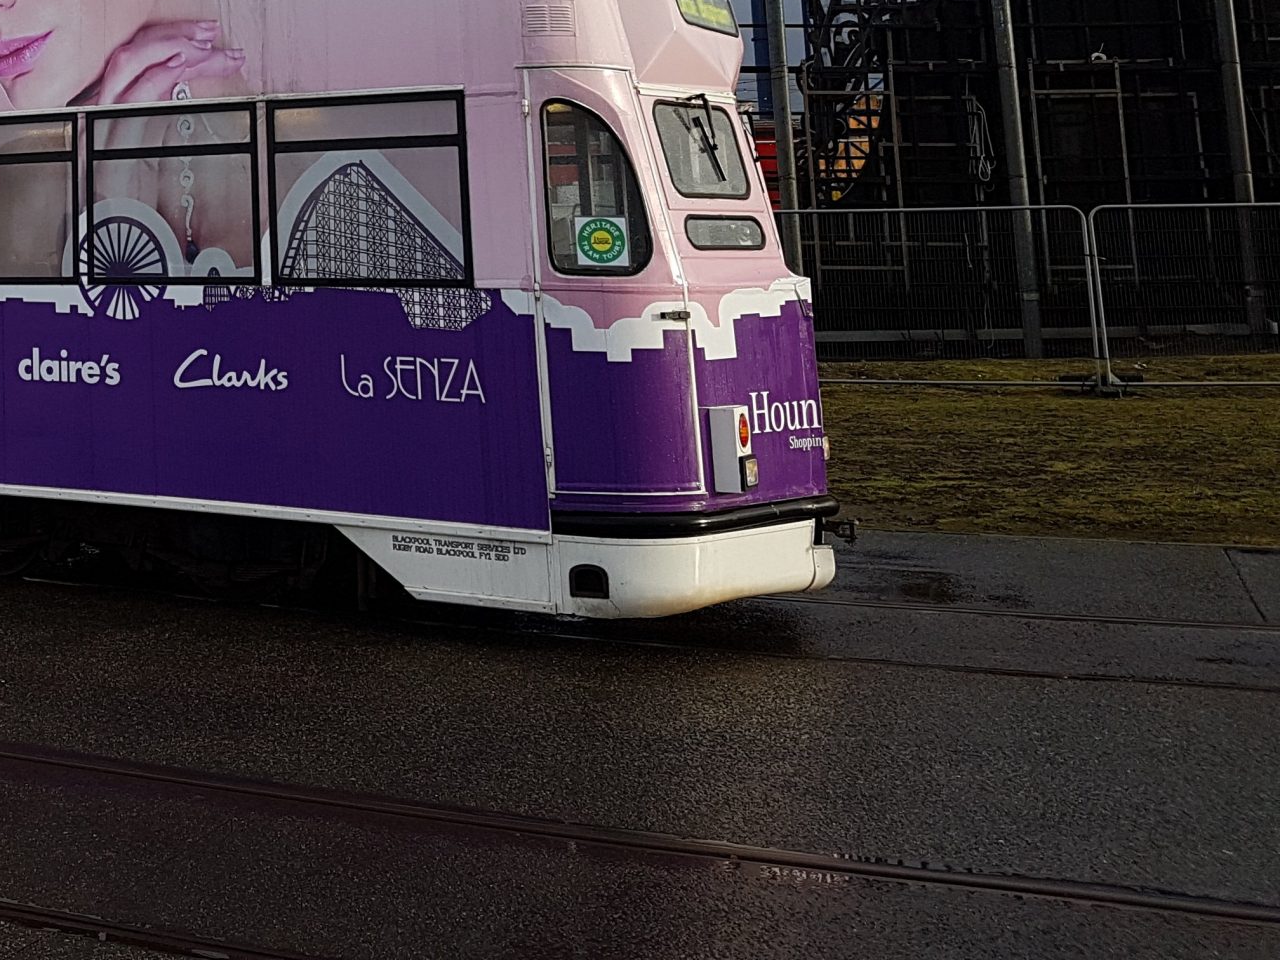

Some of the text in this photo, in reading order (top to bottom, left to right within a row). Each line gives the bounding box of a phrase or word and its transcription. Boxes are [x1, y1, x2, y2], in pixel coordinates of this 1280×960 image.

[582, 221, 620, 237] HERITAGE
[581, 240, 622, 260] TRAM TOURS
[18, 347, 121, 386] claire's
[173, 348, 289, 391] Clarks
[339, 353, 486, 404] La SENZA
[392, 535, 527, 556] BLACKPOOL TRANSPORT SERVICES LTD
[392, 542, 413, 553] RIGBY
[415, 545, 434, 555] ROAD
[436, 547, 477, 559] BLACKPOOL
